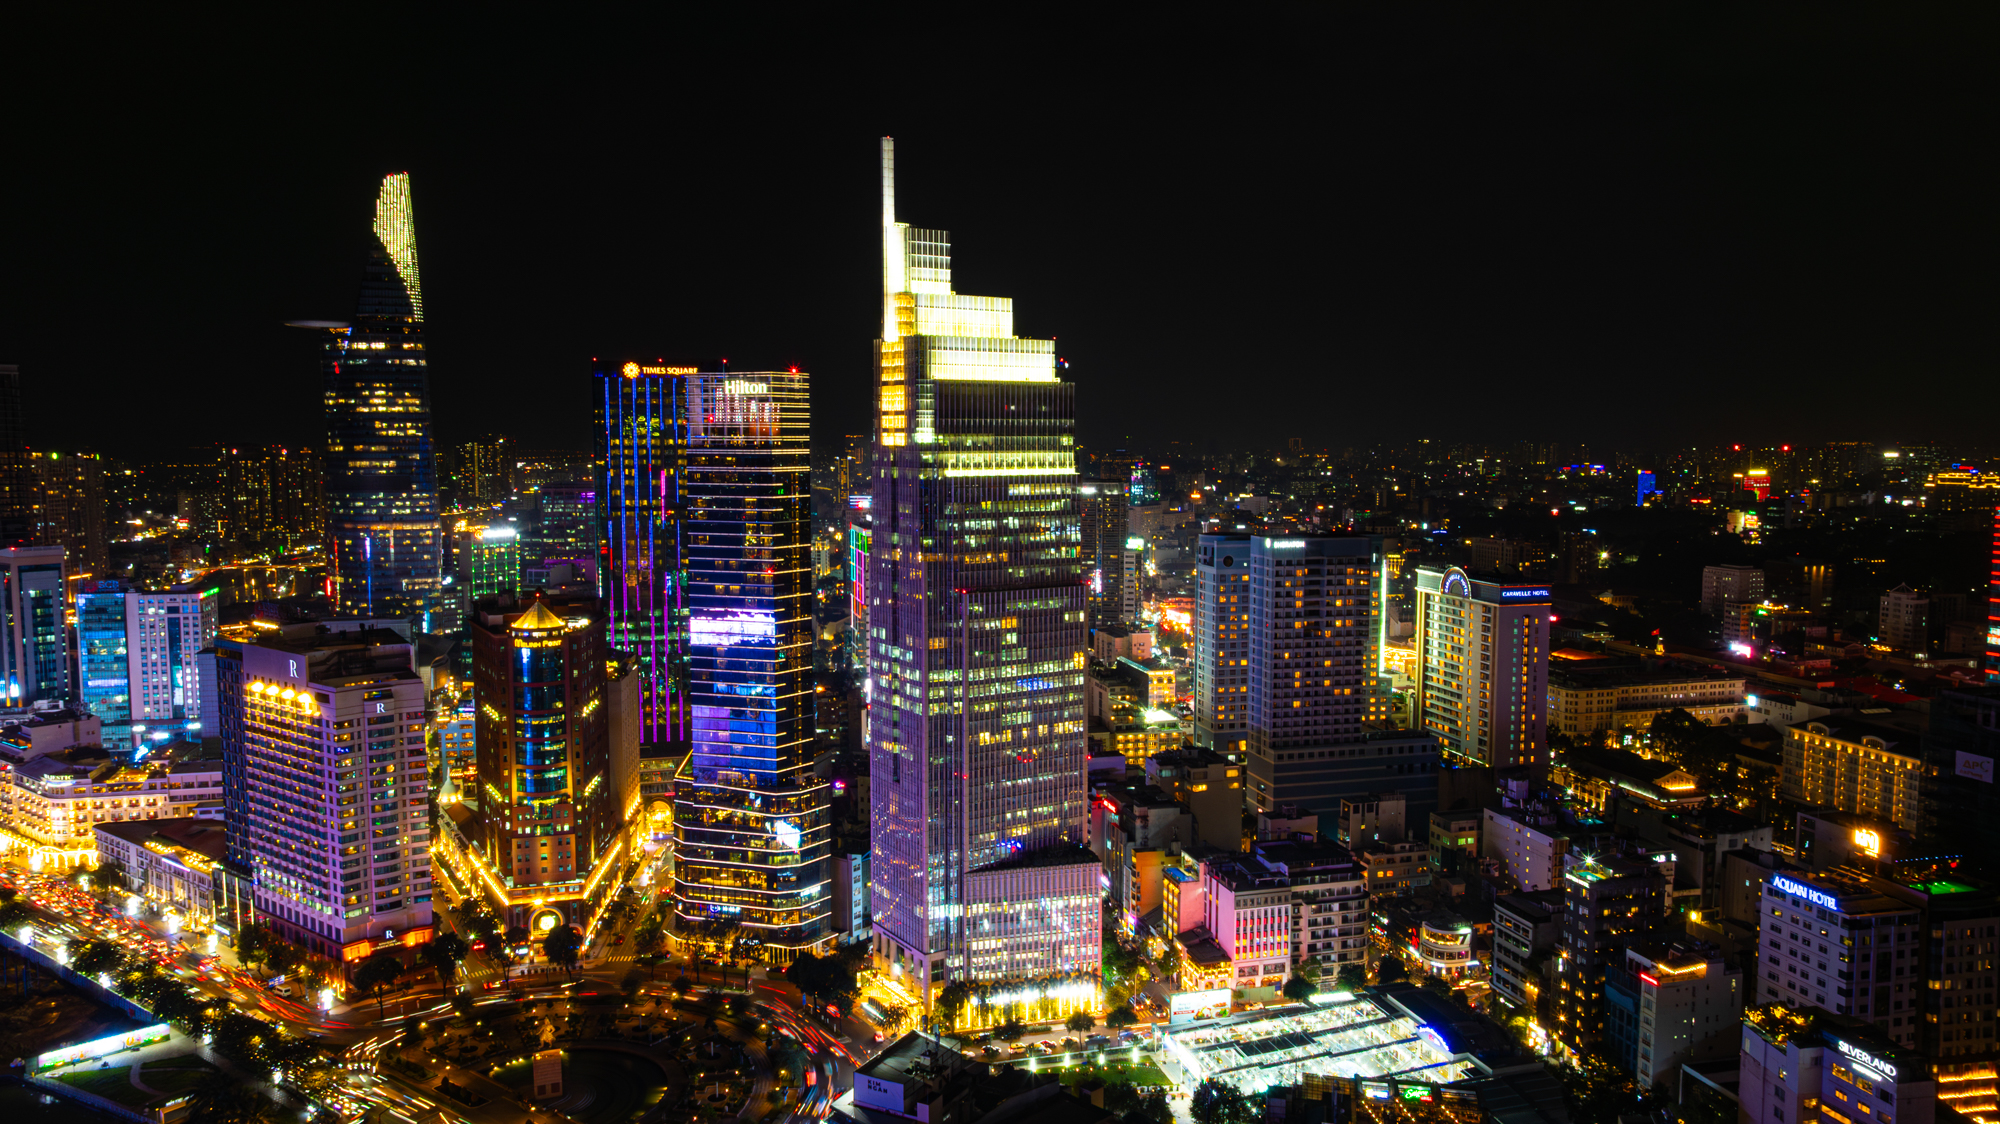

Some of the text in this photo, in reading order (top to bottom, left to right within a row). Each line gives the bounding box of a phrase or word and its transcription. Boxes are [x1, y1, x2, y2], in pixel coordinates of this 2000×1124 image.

[642, 366, 698, 375] TIMES SQUARE
[725, 380, 767, 394] Hilton
[1444, 573, 1461, 593] CARAVELLE
[289, 659, 299, 678] R
[376, 702, 386, 713] R
[1808, 889, 1838, 910] HOTEL
[386, 929, 394, 939] R
[1838, 1040, 1896, 1077] SILVERLAND
